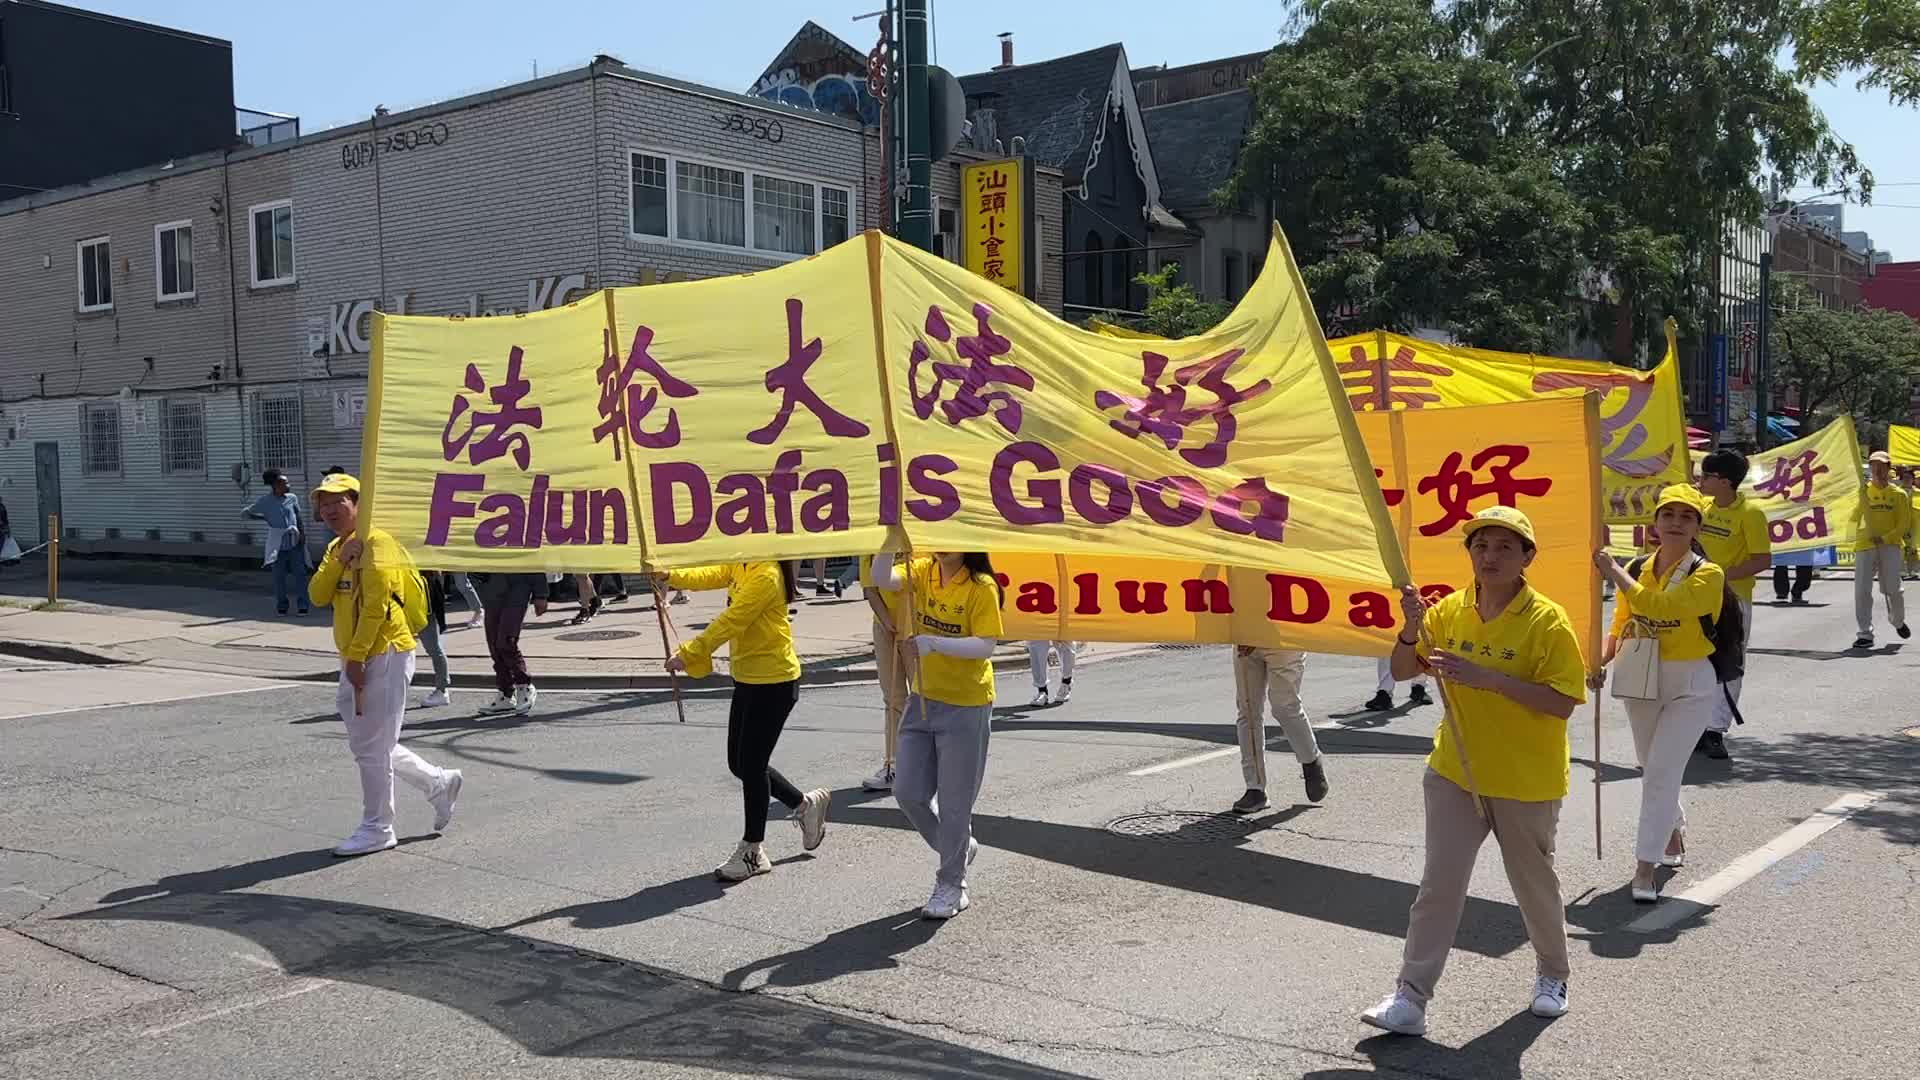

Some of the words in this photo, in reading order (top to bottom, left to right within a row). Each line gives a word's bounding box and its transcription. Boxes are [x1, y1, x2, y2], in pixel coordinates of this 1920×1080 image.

[424, 473, 629, 549] Falun
[649, 449, 850, 545] Dafa
[878, 442, 962, 526] is
[990, 440, 1290, 543] Good
[1375, 443, 1553, 538] 好
[1767, 506, 1829, 544] od
[993, 572, 1234, 616] alun
[1265, 572, 1457, 630] Da
